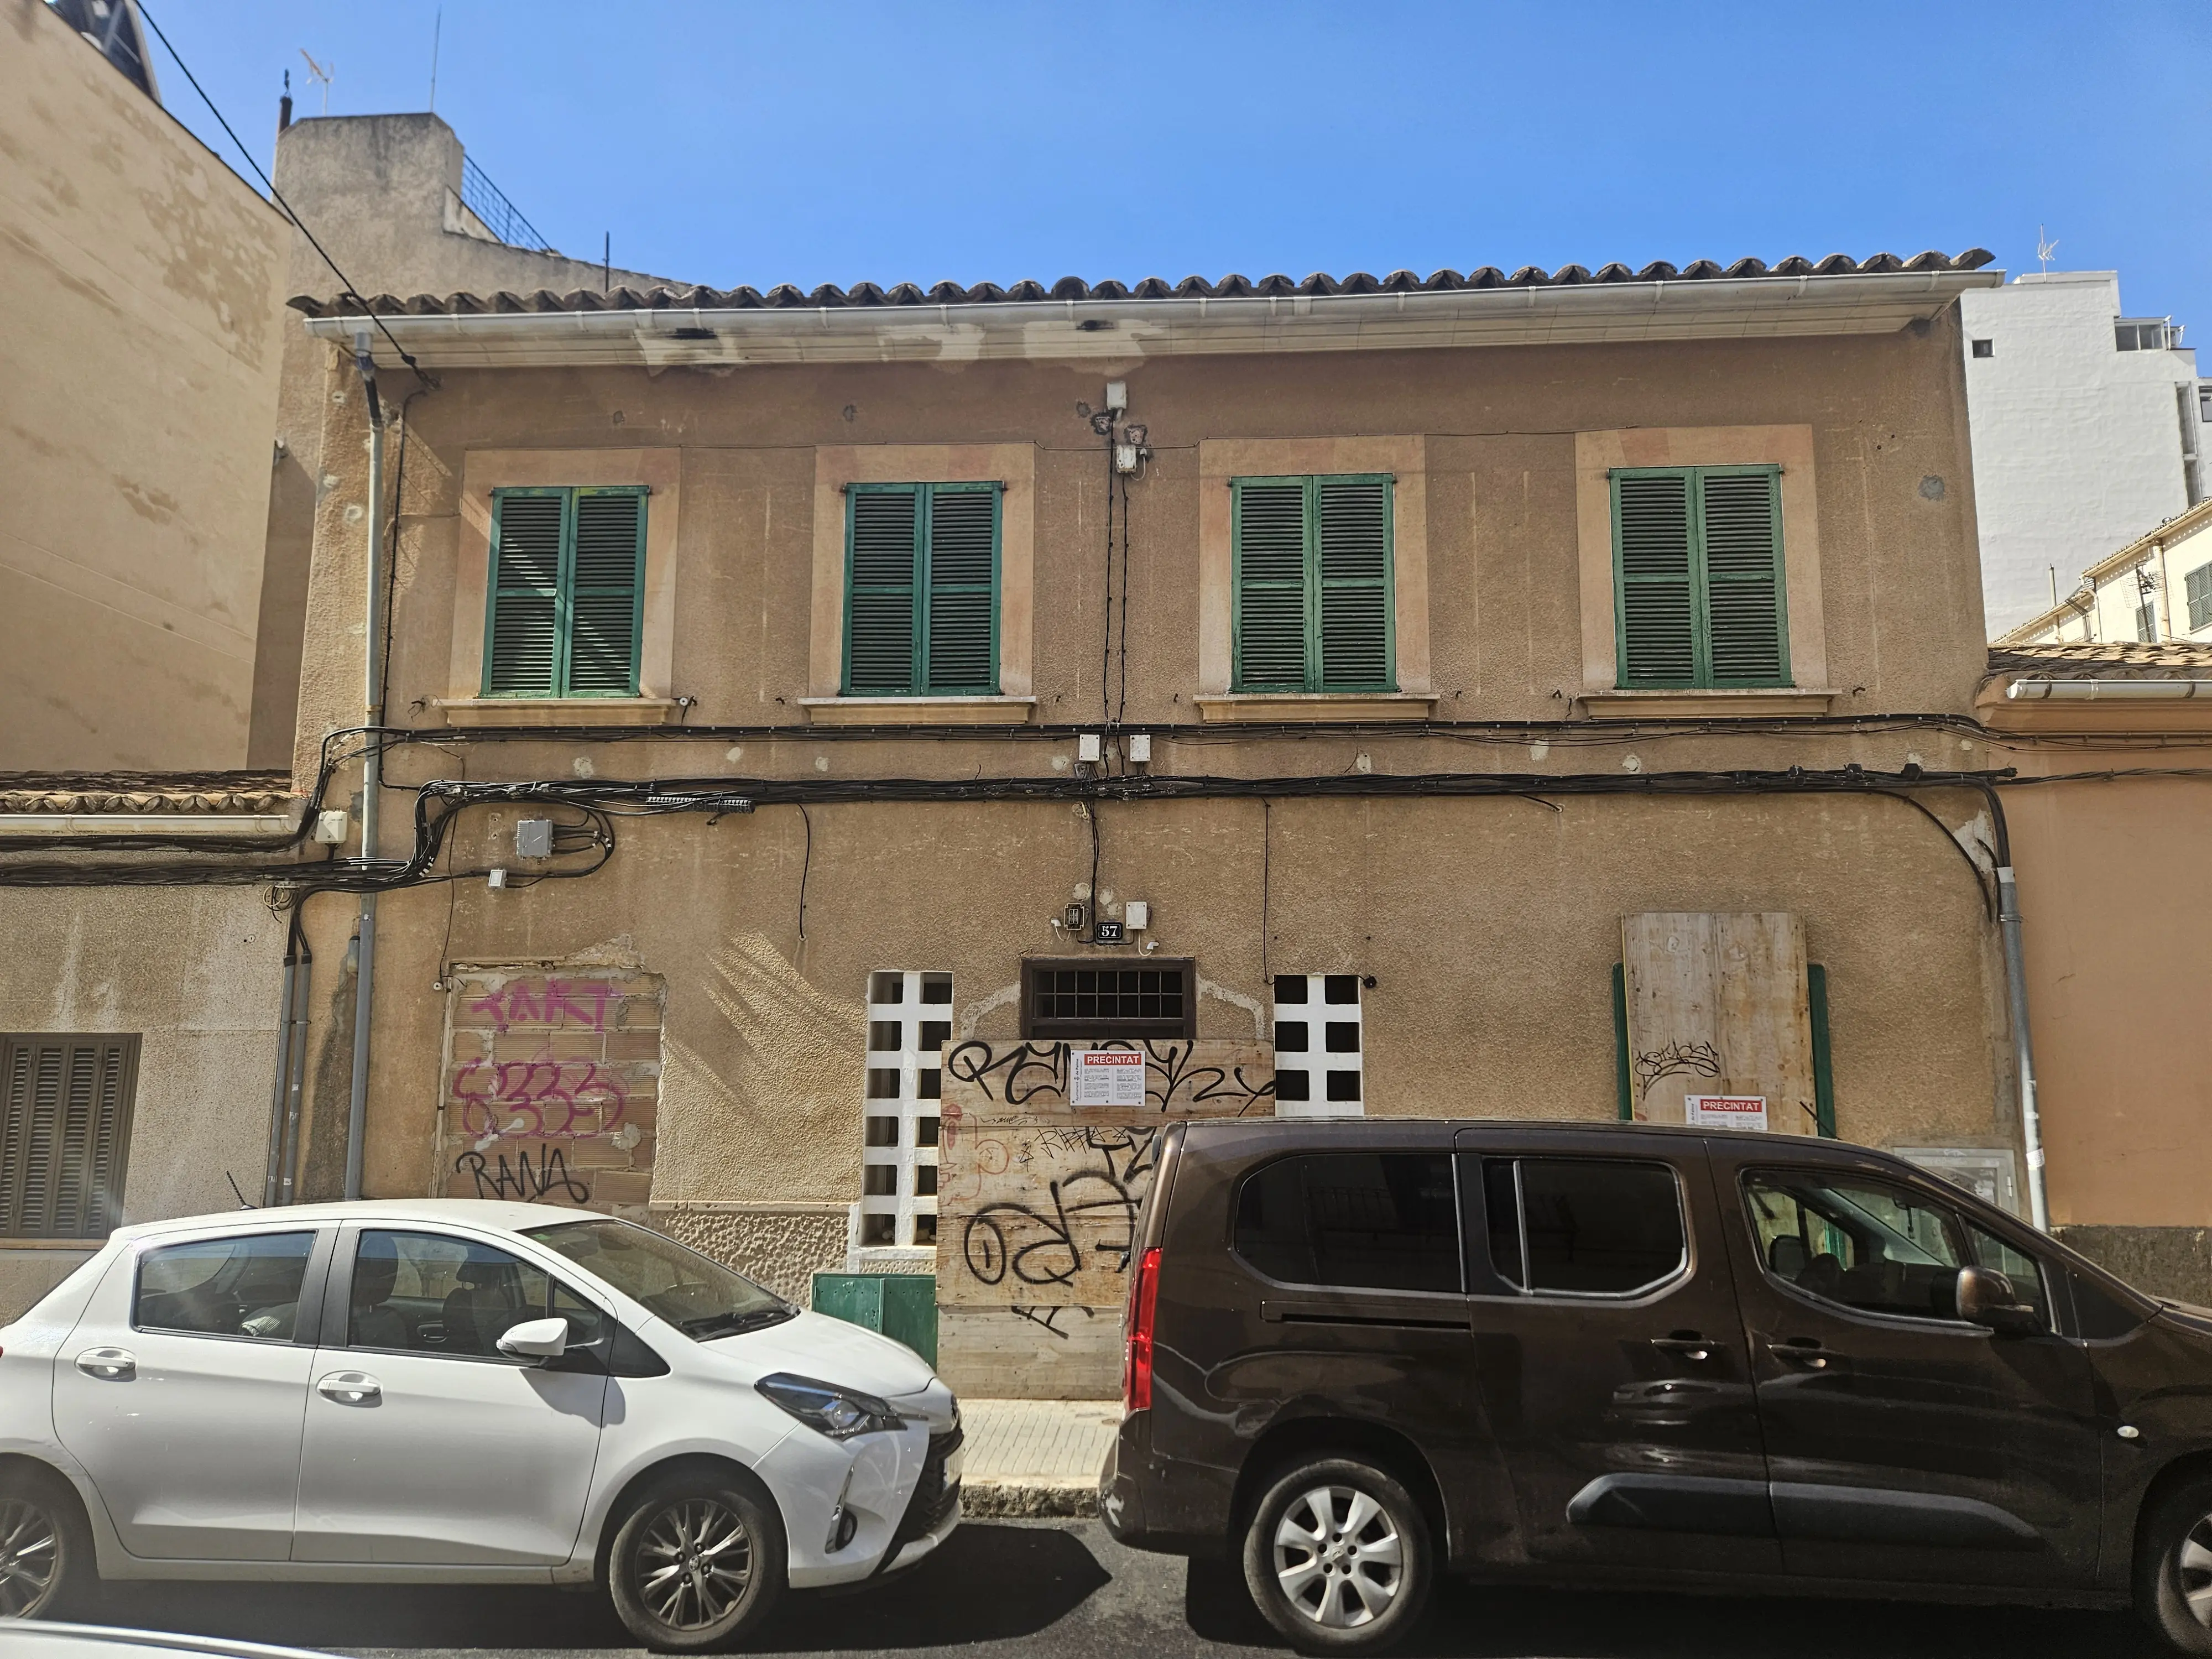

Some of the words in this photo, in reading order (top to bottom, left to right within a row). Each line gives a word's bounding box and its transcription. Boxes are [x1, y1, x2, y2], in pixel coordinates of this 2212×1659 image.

[1102, 925, 1118, 937] 57
[1087, 1056, 1139, 1064] PRECINTAT
[1703, 1101, 1759, 1110] PRECINTAT
